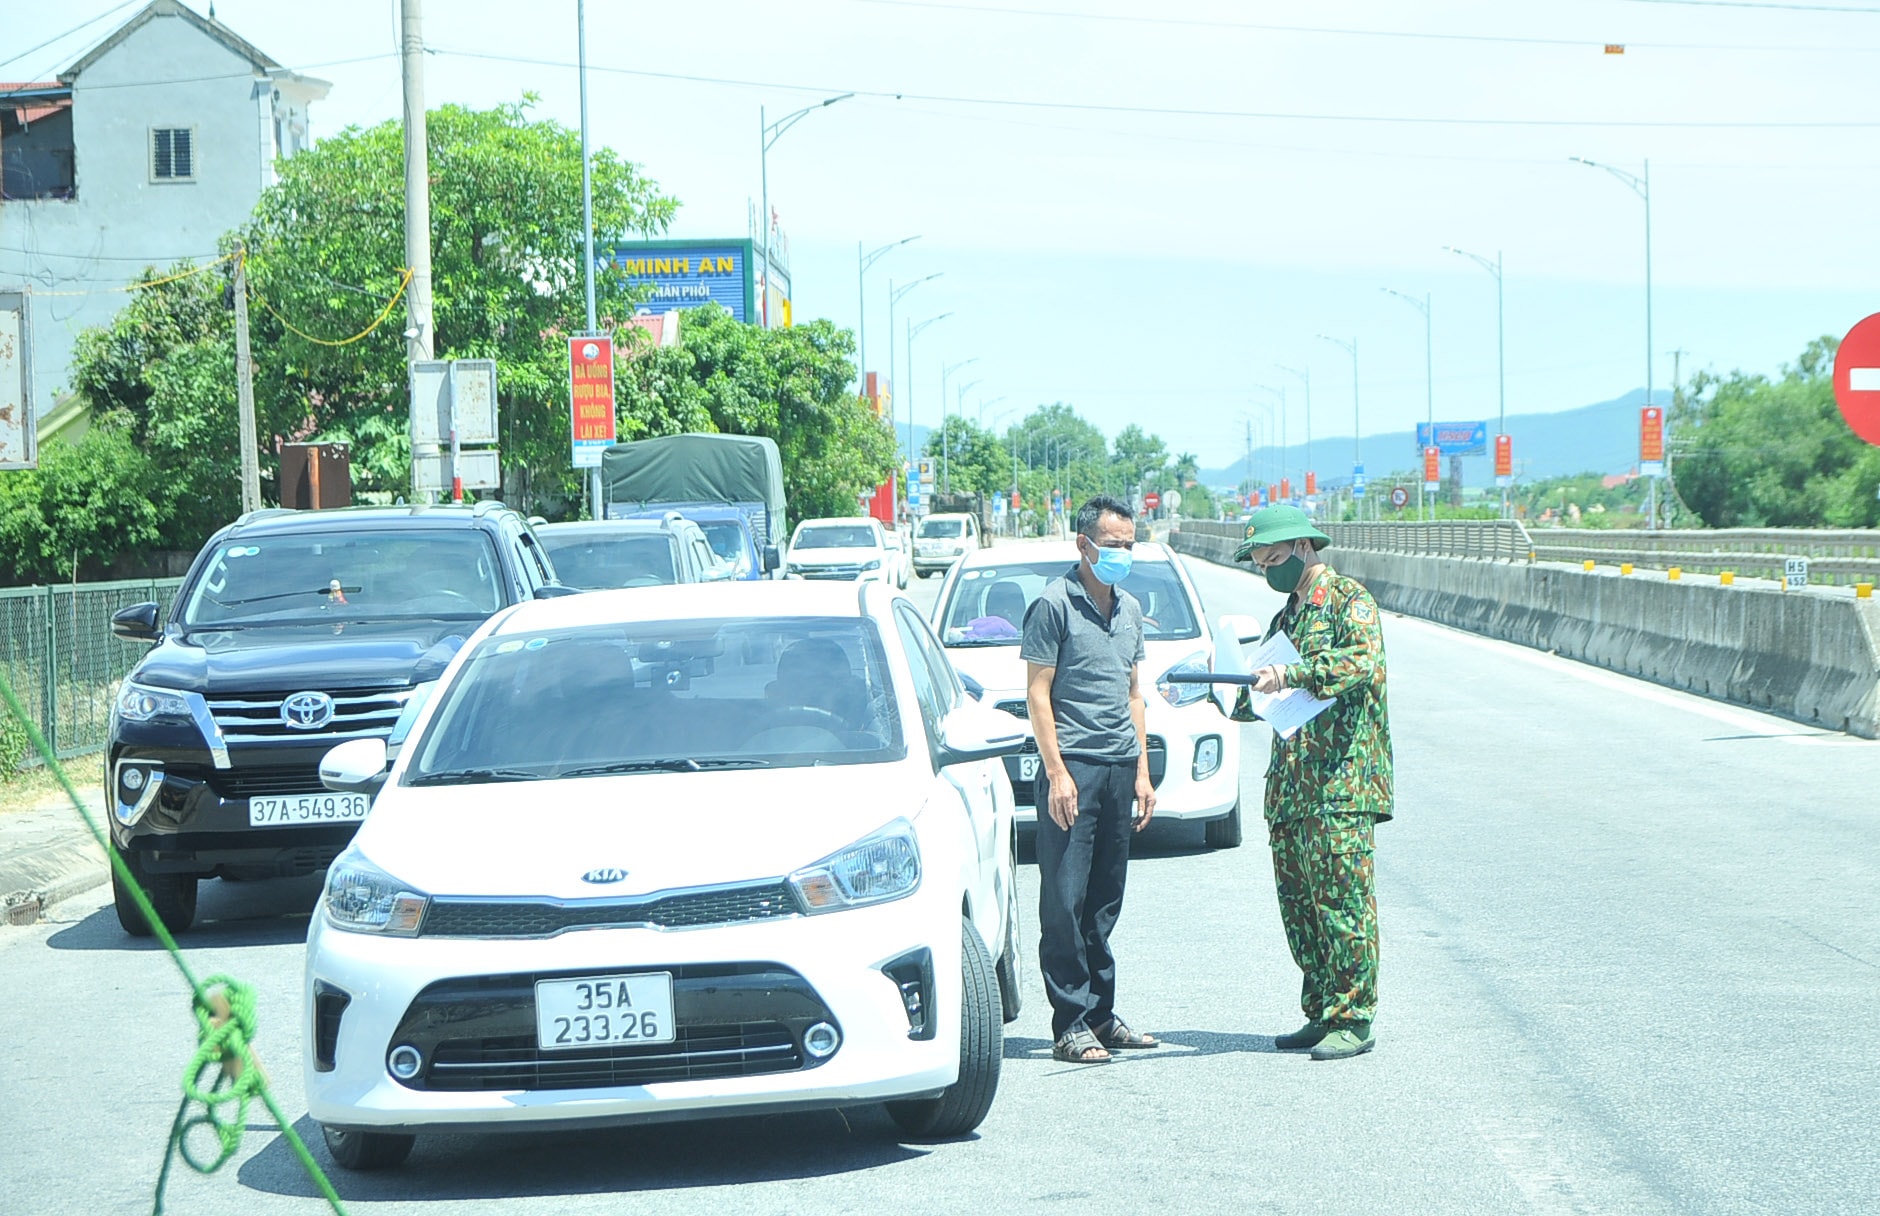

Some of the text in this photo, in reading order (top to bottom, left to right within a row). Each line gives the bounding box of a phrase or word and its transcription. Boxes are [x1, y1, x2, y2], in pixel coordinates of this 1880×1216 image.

[626, 256, 734, 274] MINH AN
[682, 280, 710, 297] PHỐI
[580, 402, 606, 418] KHÔNG
[253, 796, 365, 822] 37A-549.36
[588, 868, 624, 882] KIA
[575, 981, 633, 1011] 35A
[554, 1011, 658, 1044] 233.26
